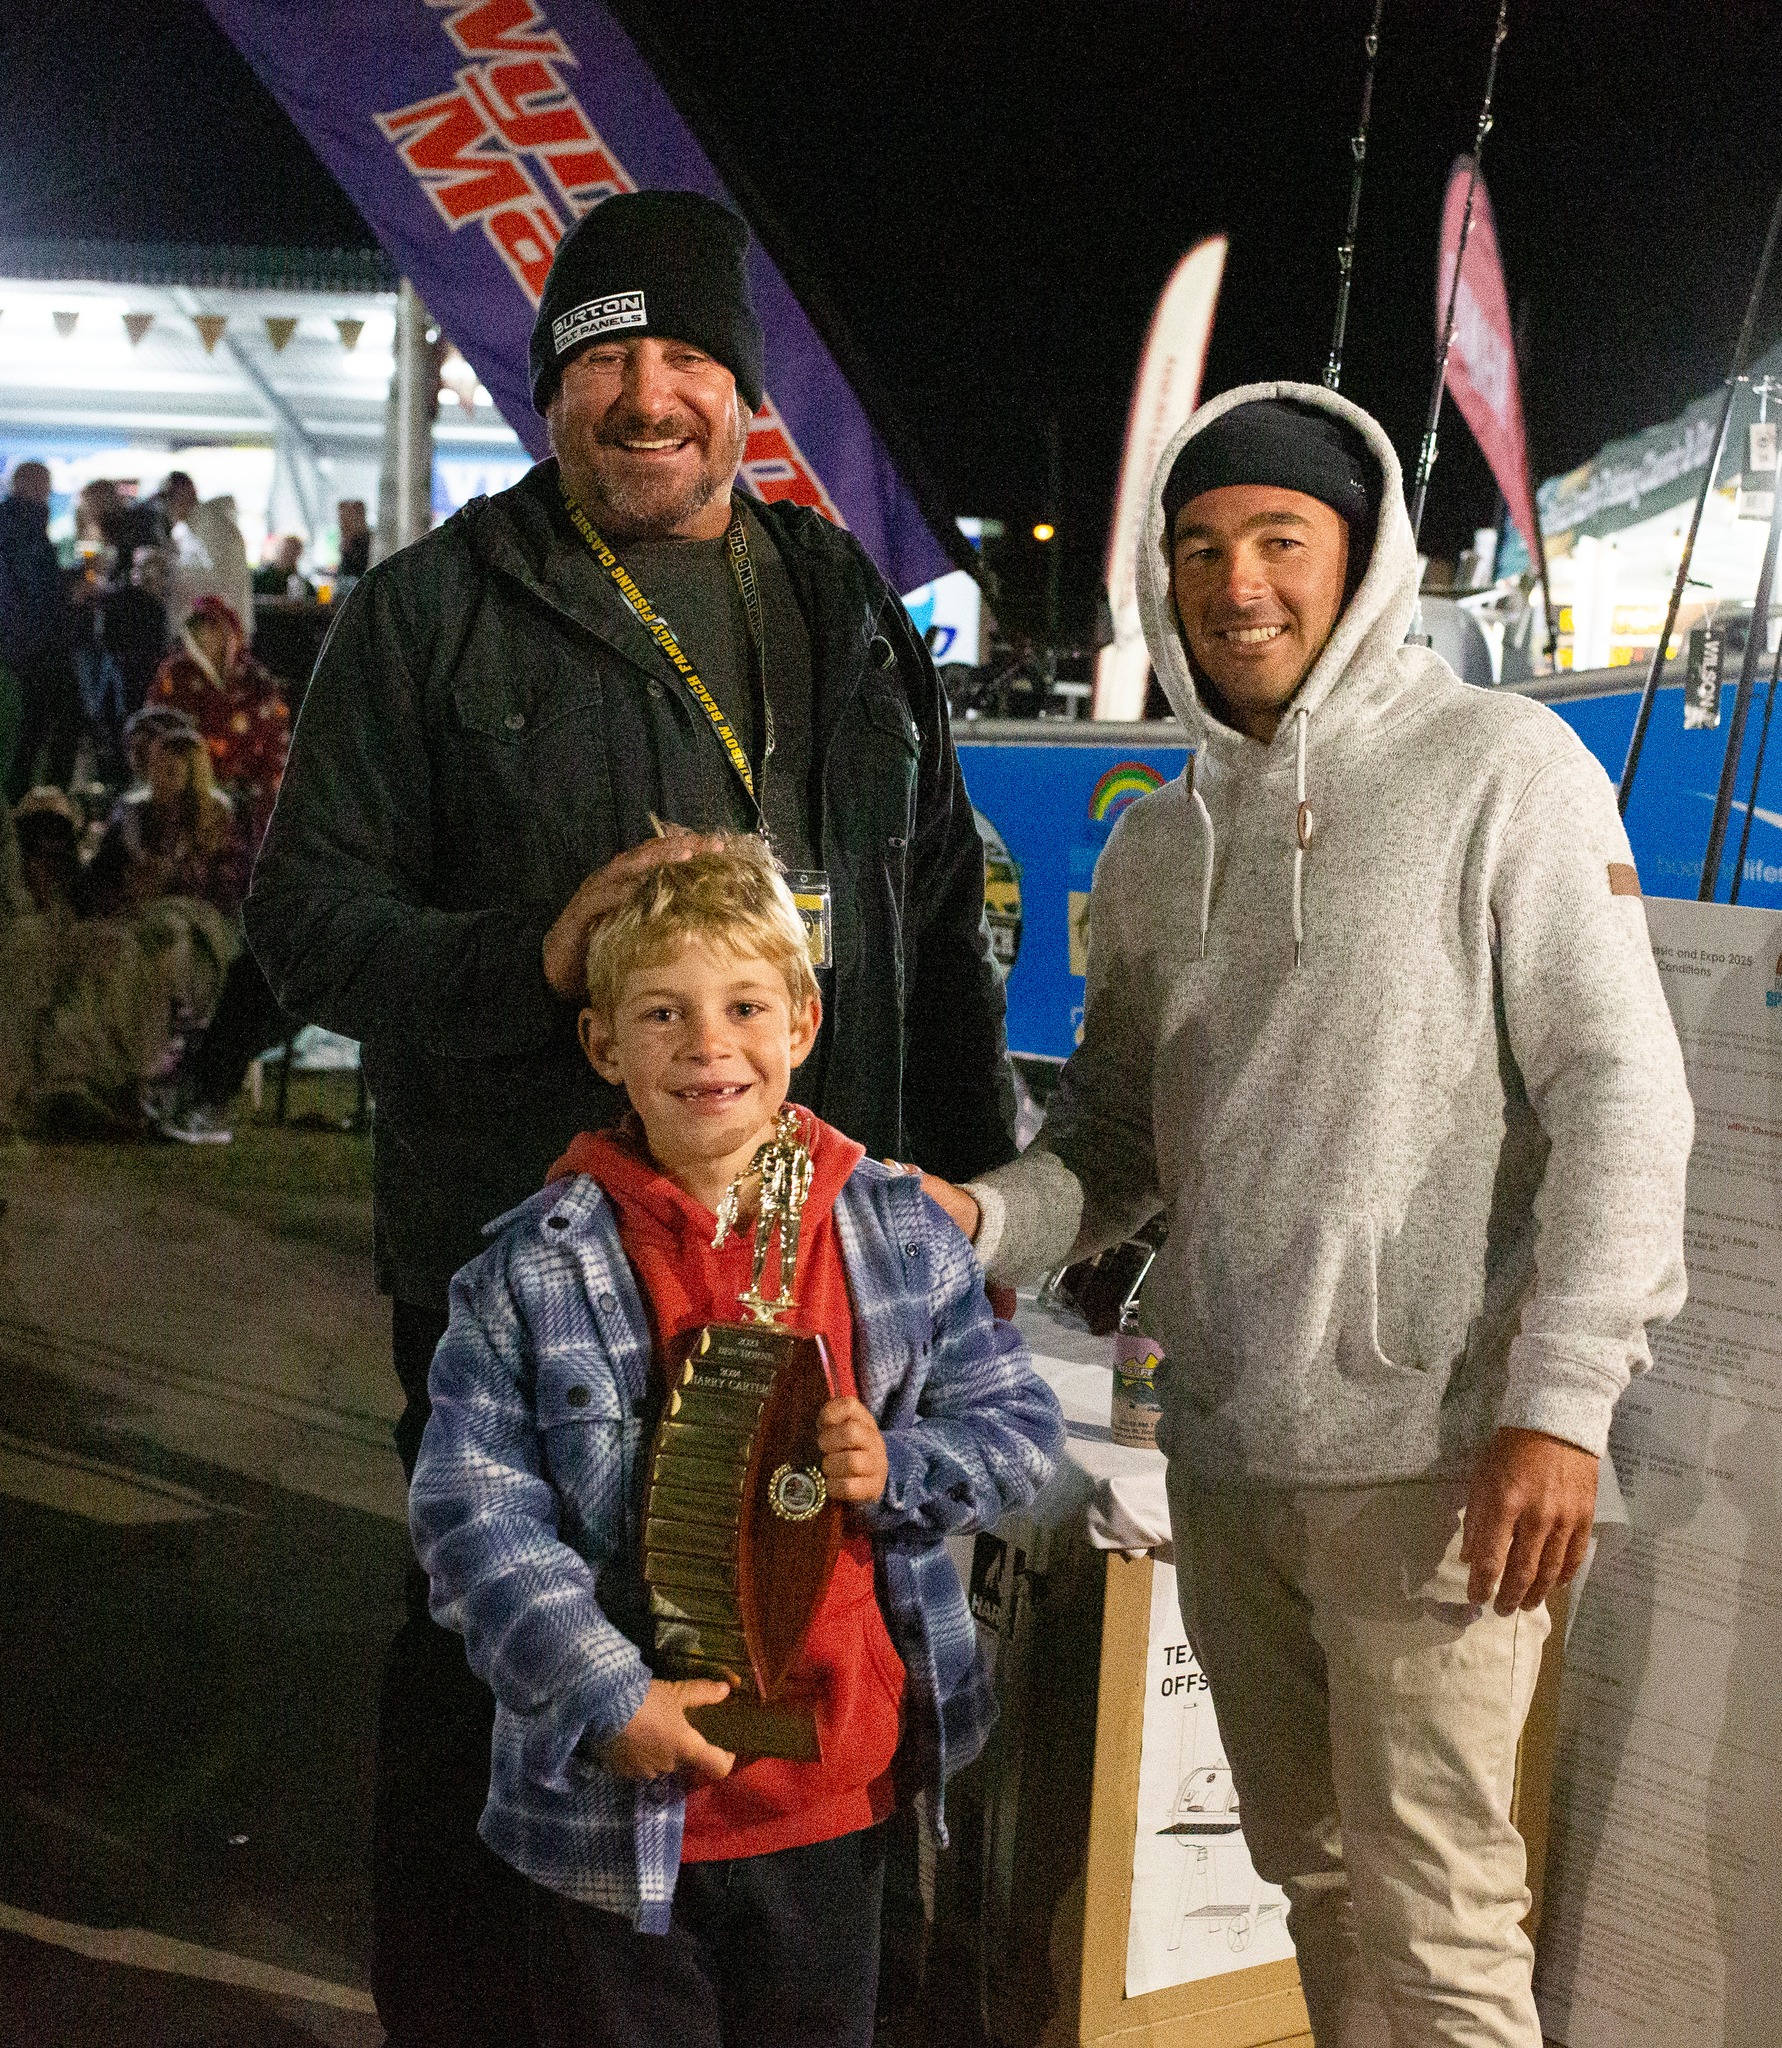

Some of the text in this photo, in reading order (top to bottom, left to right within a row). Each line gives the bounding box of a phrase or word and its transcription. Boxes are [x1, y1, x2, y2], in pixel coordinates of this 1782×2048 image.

[555, 297, 640, 336] BURTON
[580, 314, 641, 335] PANELS
[570, 507, 615, 566] CLASSIC
[729, 519, 748, 558] CLAS
[610, 566, 657, 623] FISHING
[650, 623, 692, 673] FAMILY
[1699, 639, 1719, 709] WILSON
[686, 675, 724, 722] BEACH
[1743, 858, 1782, 884] life
[1657, 960, 1711, 977] Conditions
[1677, 949, 1697, 961] and
[1700, 950, 1726, 965] Expo
[1729, 953, 1754, 967] 2025
